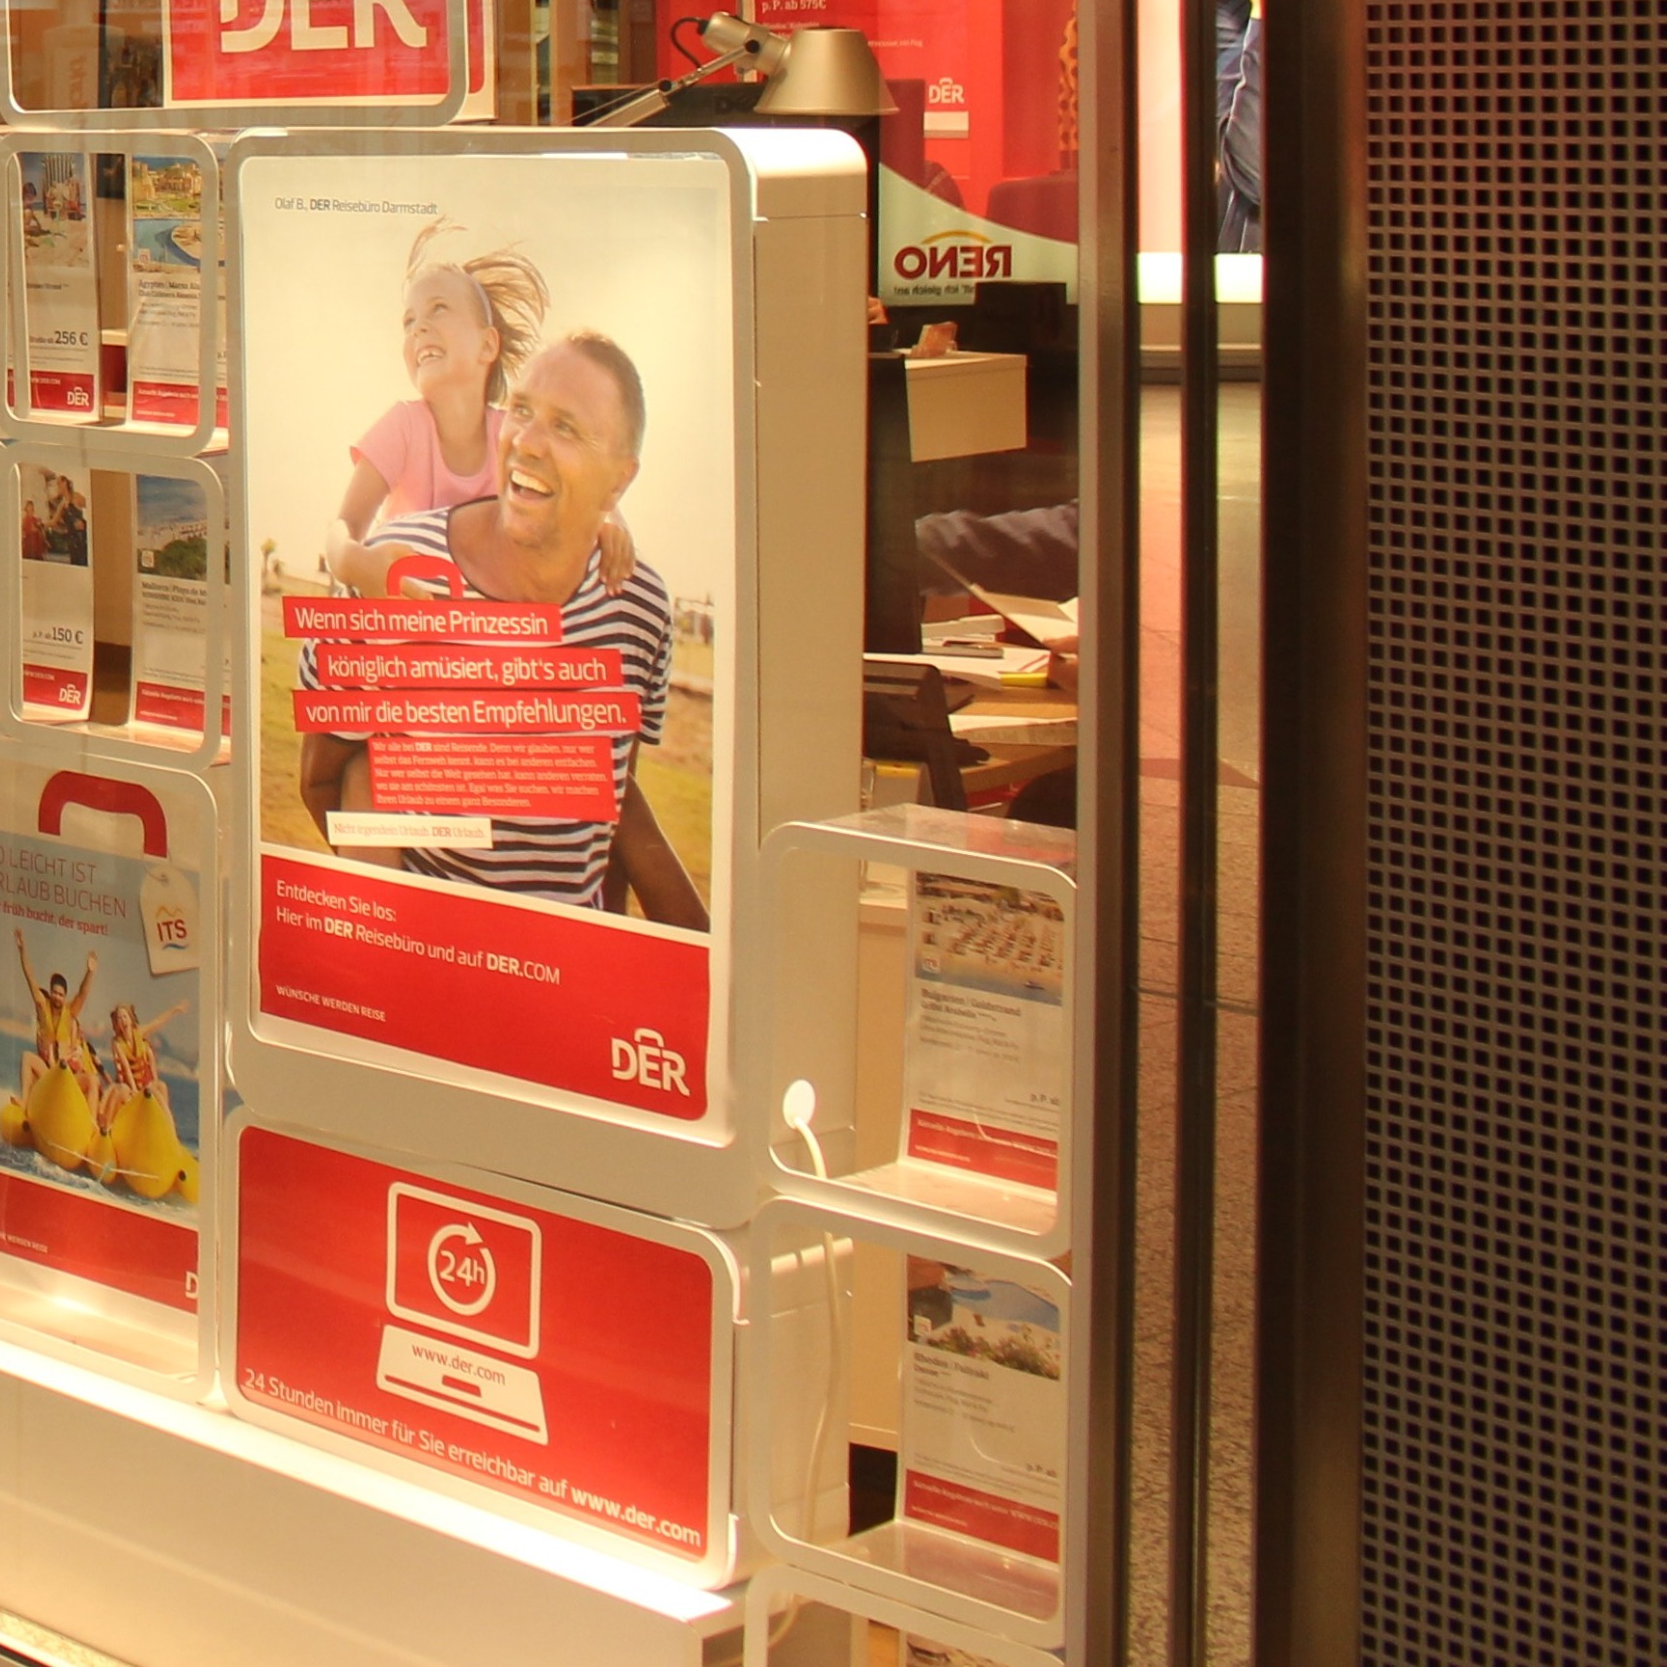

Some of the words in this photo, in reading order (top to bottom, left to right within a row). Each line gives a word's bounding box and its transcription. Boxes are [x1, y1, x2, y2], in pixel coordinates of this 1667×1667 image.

[928, 84, 965, 104] DER
[275, 197, 294, 209] Olaf
[310, 199, 330, 211] DER
[333, 200, 380, 213] Reisebüro
[382, 201, 438, 215] Darmstadt
[55, 330, 76, 345] 256
[79, 332, 88, 346] €
[67, 391, 89, 406] DER
[52, 627, 71, 643] 150
[75, 631, 83, 644] €
[294, 607, 347, 631] Wenn
[349, 609, 387, 632] sich
[389, 611, 446, 634] meine
[449, 610, 549, 636] Prinzessin
[327, 655, 407, 685] königlich
[410, 657, 498, 683] amüsiert,
[561, 658, 607, 682] auch
[59, 687, 80, 705] DER
[306, 704, 340, 723] von
[342, 700, 372, 724] mir
[375, 699, 404, 724] die
[405, 698, 471, 725] besten
[473, 698, 627, 730] Empfehlungen.
[415, 742, 432, 752] DER
[432, 826, 451, 837] DER
[9, 849, 67, 878] LEICHT
[71, 862, 97, 885] IST
[55, 884, 127, 918] BUCHEN
[277, 879, 347, 912] Entdecken
[349, 894, 371, 916] Sie
[373, 899, 397, 922] los:
[3, 901, 24, 918] früh
[26, 907, 57, 925] bucht,
[58, 914, 75, 929] der
[77, 921, 108, 936] spart!
[157, 919, 187, 942] ITS
[277, 906, 304, 927] Hier
[306, 913, 322, 932] im
[324, 918, 353, 938] DER
[355, 925, 425, 956] Reisebüro
[427, 943, 454, 963] und
[457, 949, 484, 969] auf
[486, 952, 561, 986] DER.COM
[276, 985, 320, 1005] WÜNSCHE
[321, 995, 360, 1014] WERDEN
[361, 1004, 386, 1022] REISE
[610, 1036, 691, 1097] DER
[439, 1249, 486, 1287] 24h
[411, 1343, 507, 1386] www.der.com
[244, 1368, 265, 1392] 24
[269, 1377, 333, 1417] Stunden
[336, 1400, 390, 1436] immer
[392, 1419, 416, 1447] für
[418, 1429, 446, 1457] Sie
[448, 1441, 536, 1488] erreichbar
[539, 1477, 568, 1501] auf
[570, 1487, 702, 1548] www.der.com
